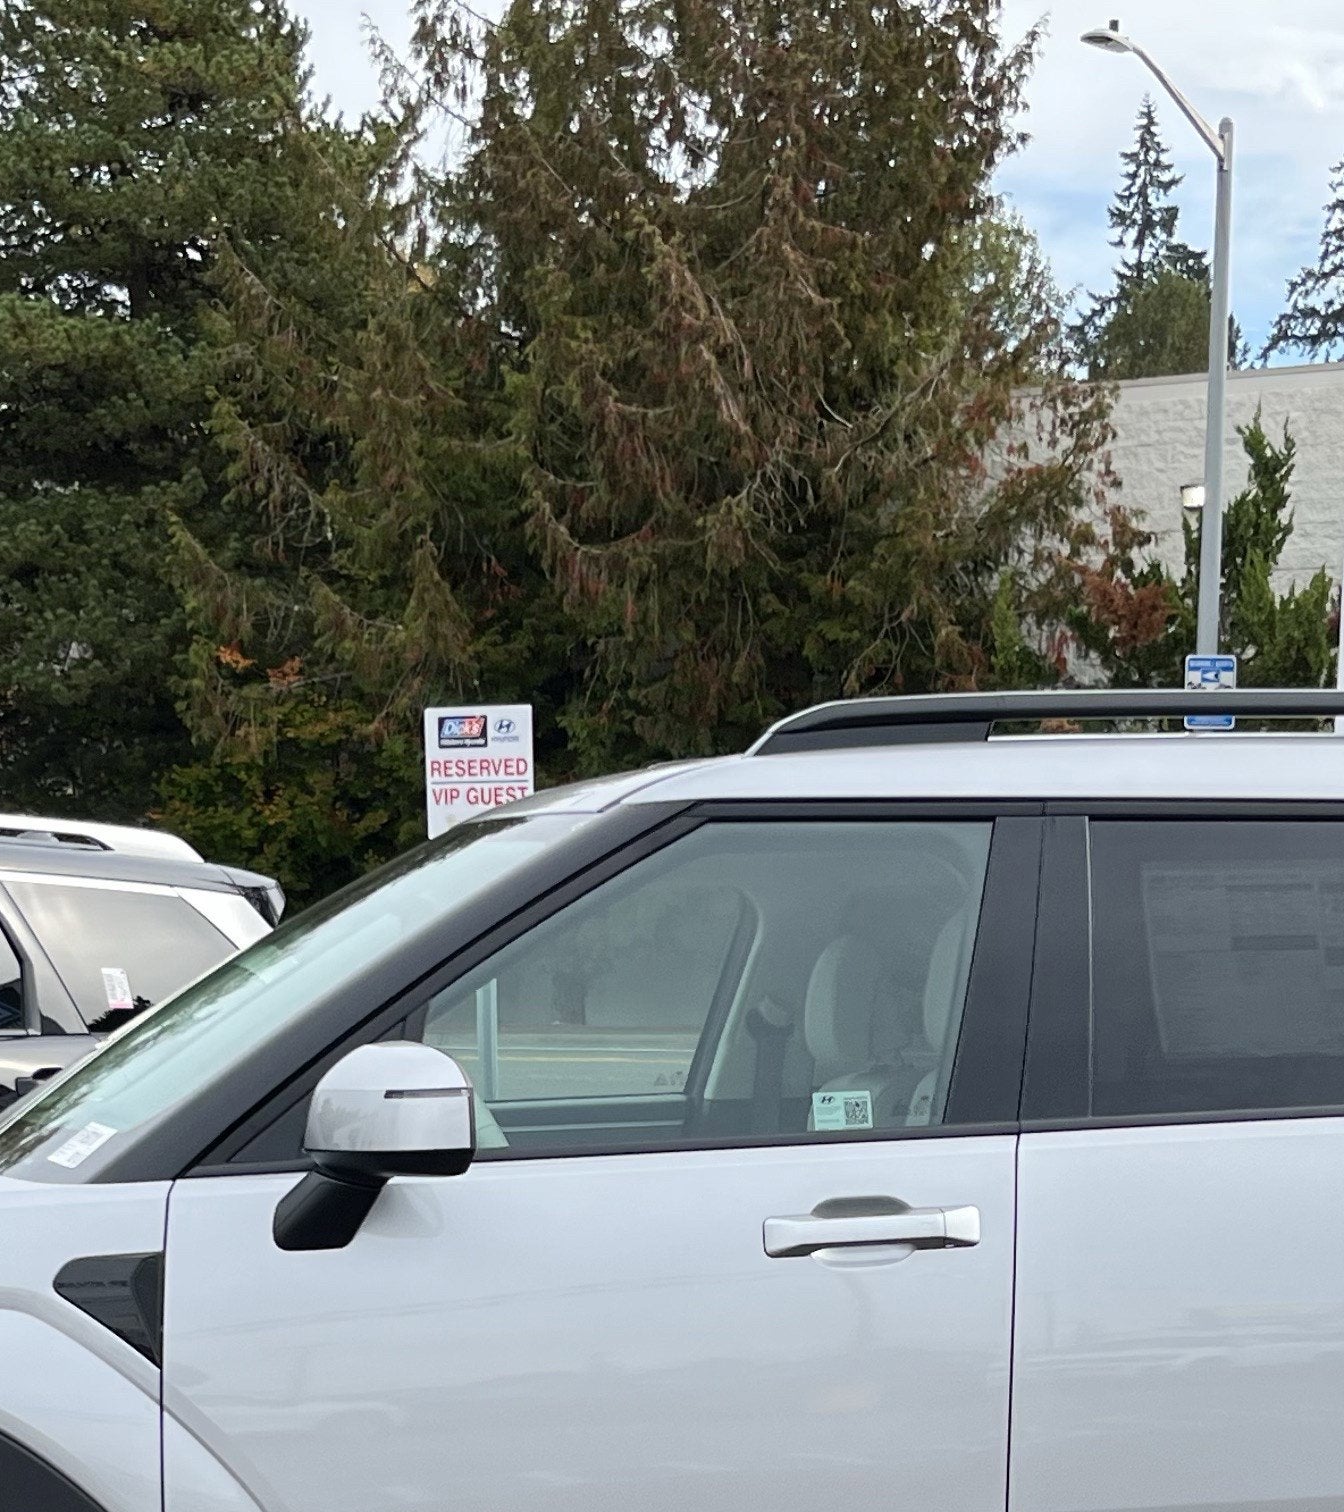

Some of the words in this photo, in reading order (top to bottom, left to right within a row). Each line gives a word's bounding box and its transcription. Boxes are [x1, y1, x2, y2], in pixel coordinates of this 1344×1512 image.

[430, 757, 528, 778] RESERVED
[432, 787, 460, 805] VIP
[466, 785, 529, 806] GUEST
